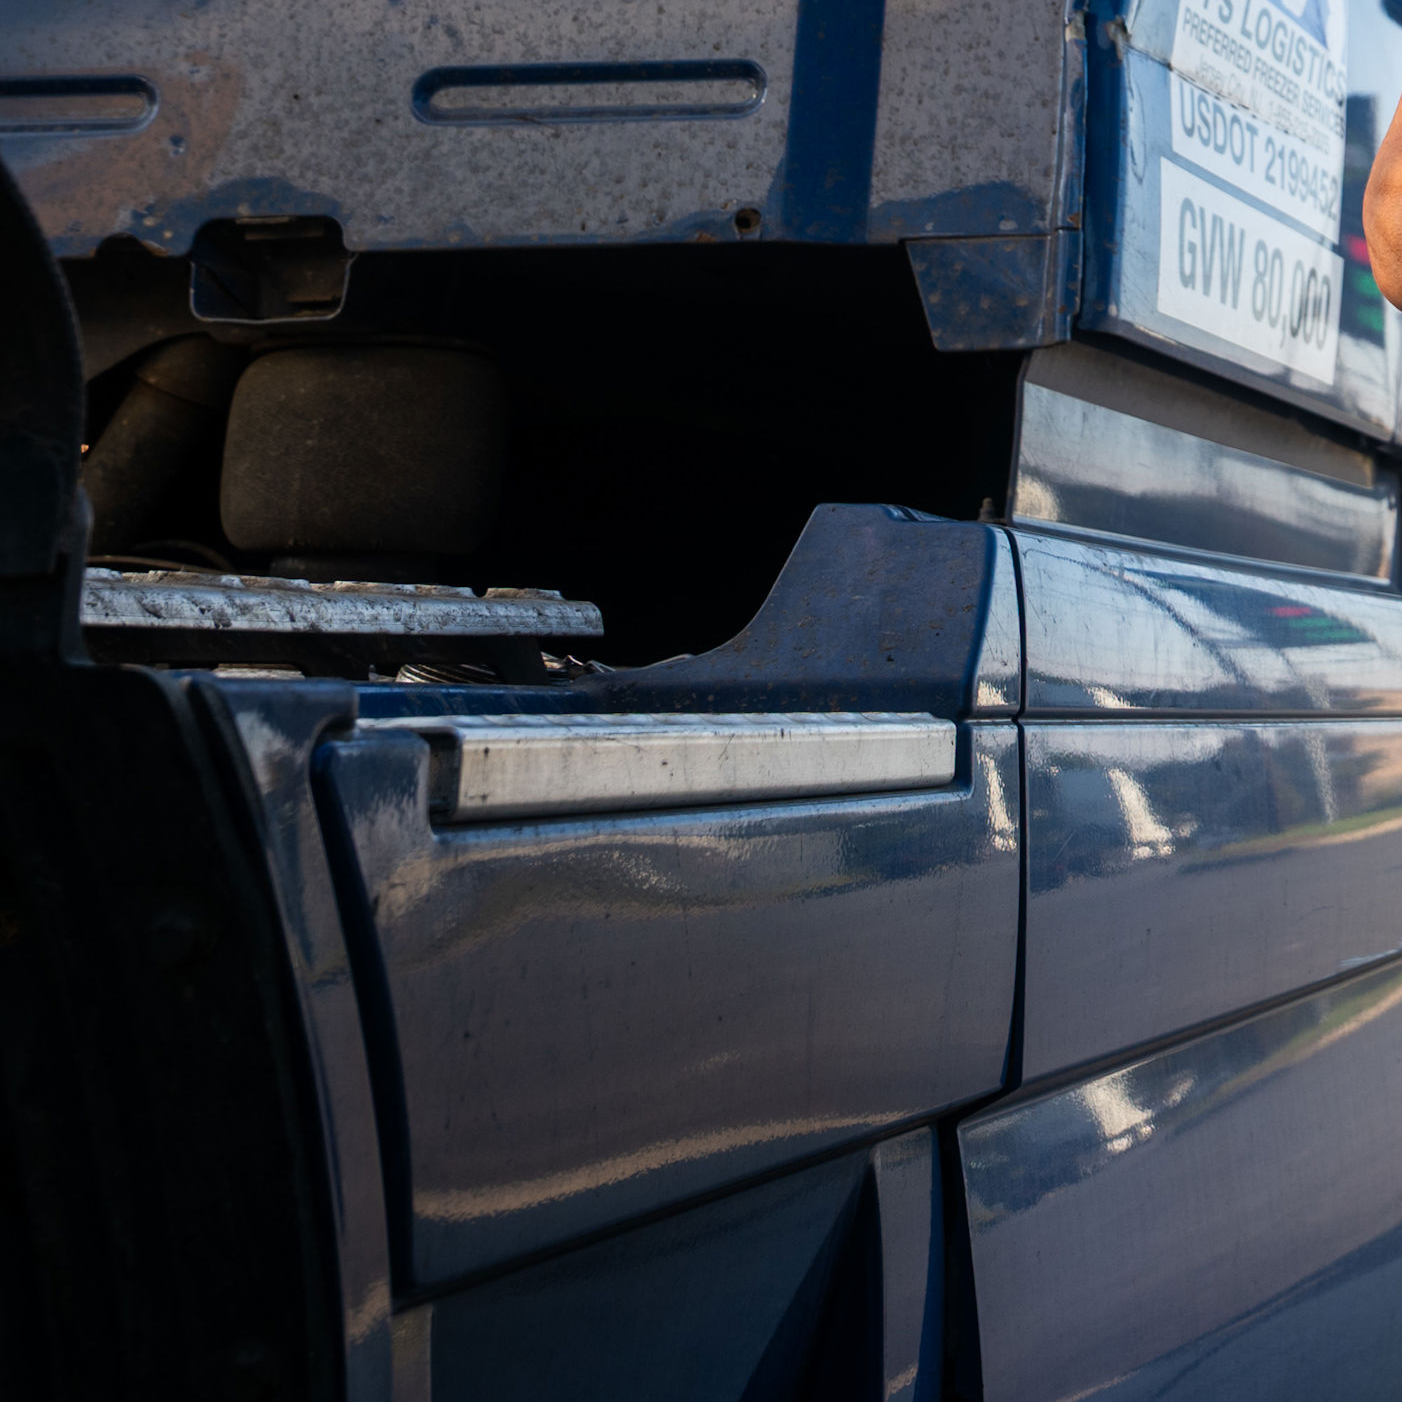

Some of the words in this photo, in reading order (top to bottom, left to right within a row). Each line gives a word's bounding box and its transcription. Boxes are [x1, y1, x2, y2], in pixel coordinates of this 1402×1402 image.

[1183, 6, 1250, 74] PREFERRED
[1252, 55, 1301, 106] FREEZER
[1180, 82, 1259, 173] USDOT
[1265, 135, 1338, 222] 2199452
[1178, 197, 1246, 310] GVW
[1252, 240, 1331, 350] 80,000
